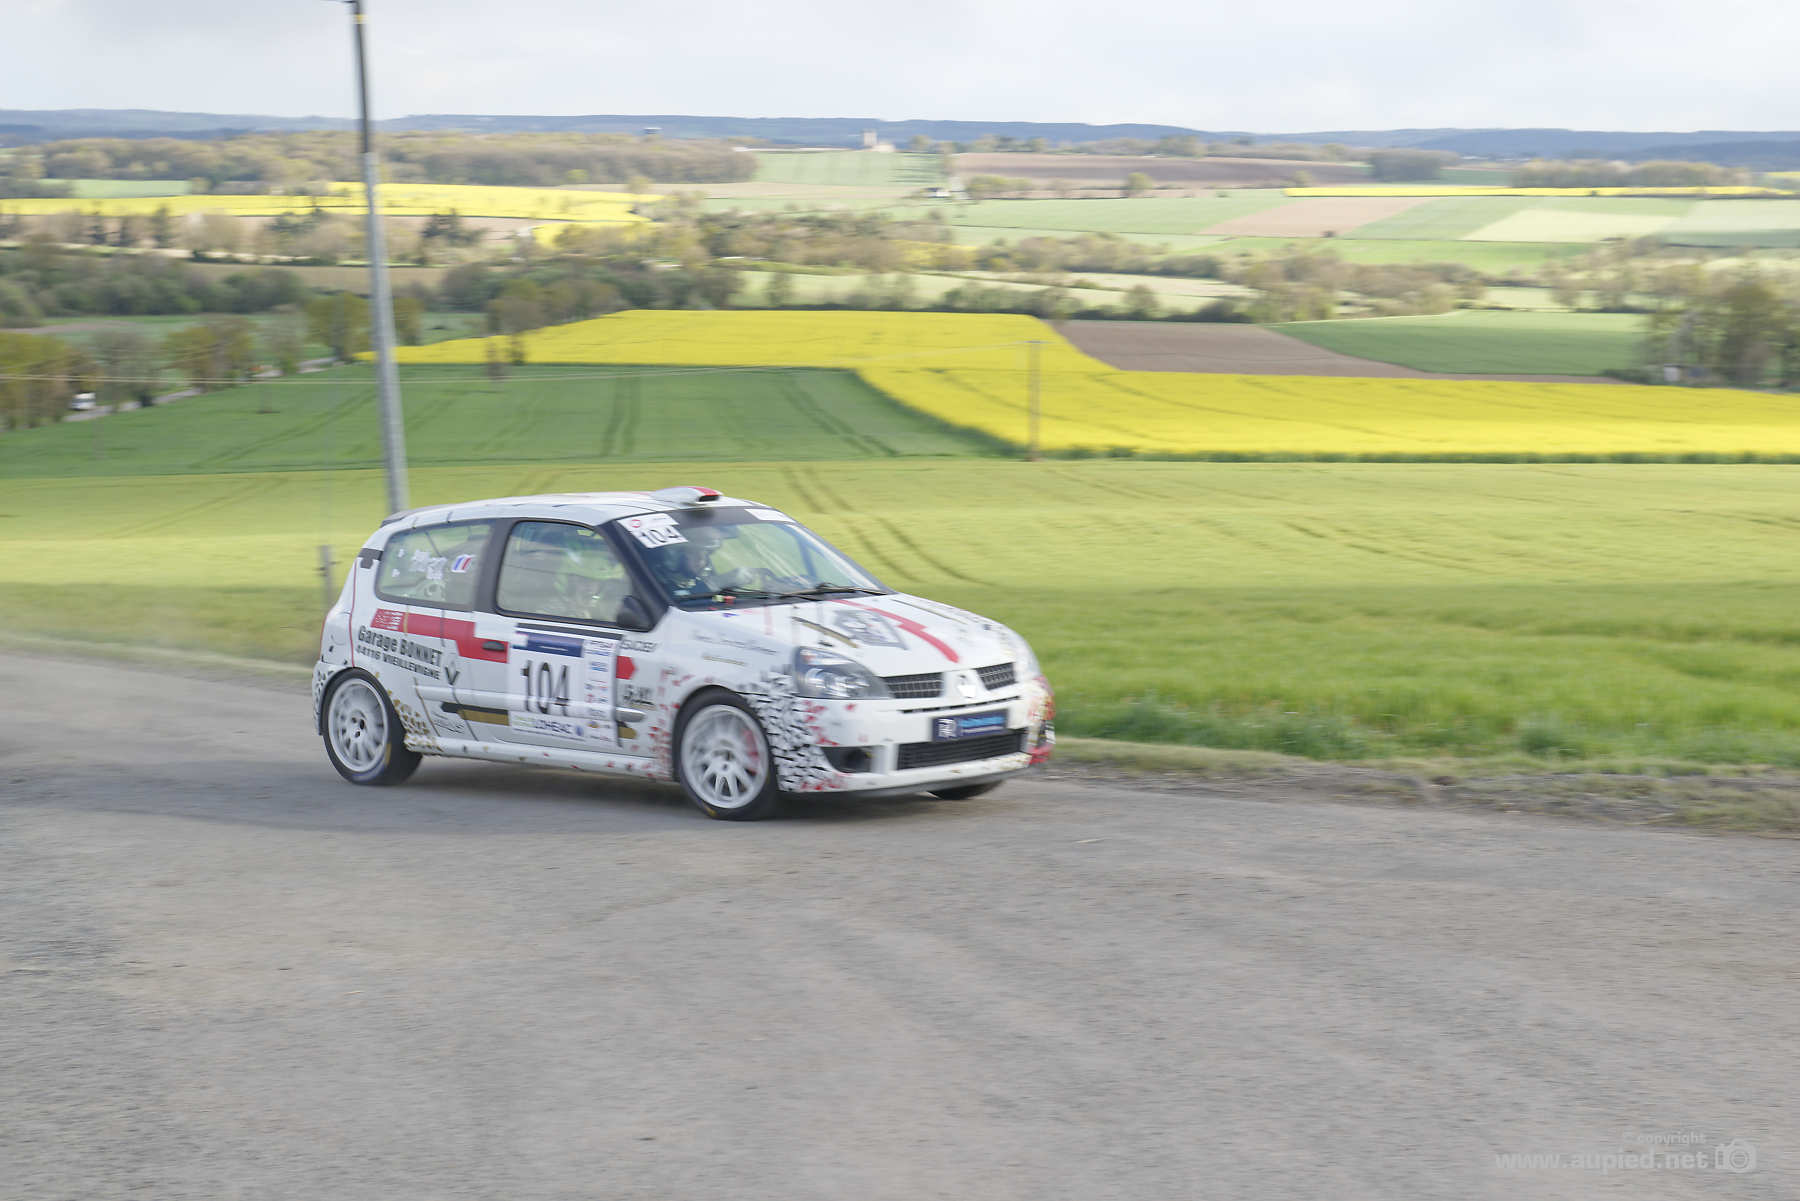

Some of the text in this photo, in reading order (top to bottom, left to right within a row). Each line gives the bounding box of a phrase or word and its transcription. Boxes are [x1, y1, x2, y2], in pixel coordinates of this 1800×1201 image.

[639, 527, 680, 546] 104
[358, 625, 442, 668] Garage BONNET
[521, 659, 570, 717] 104
